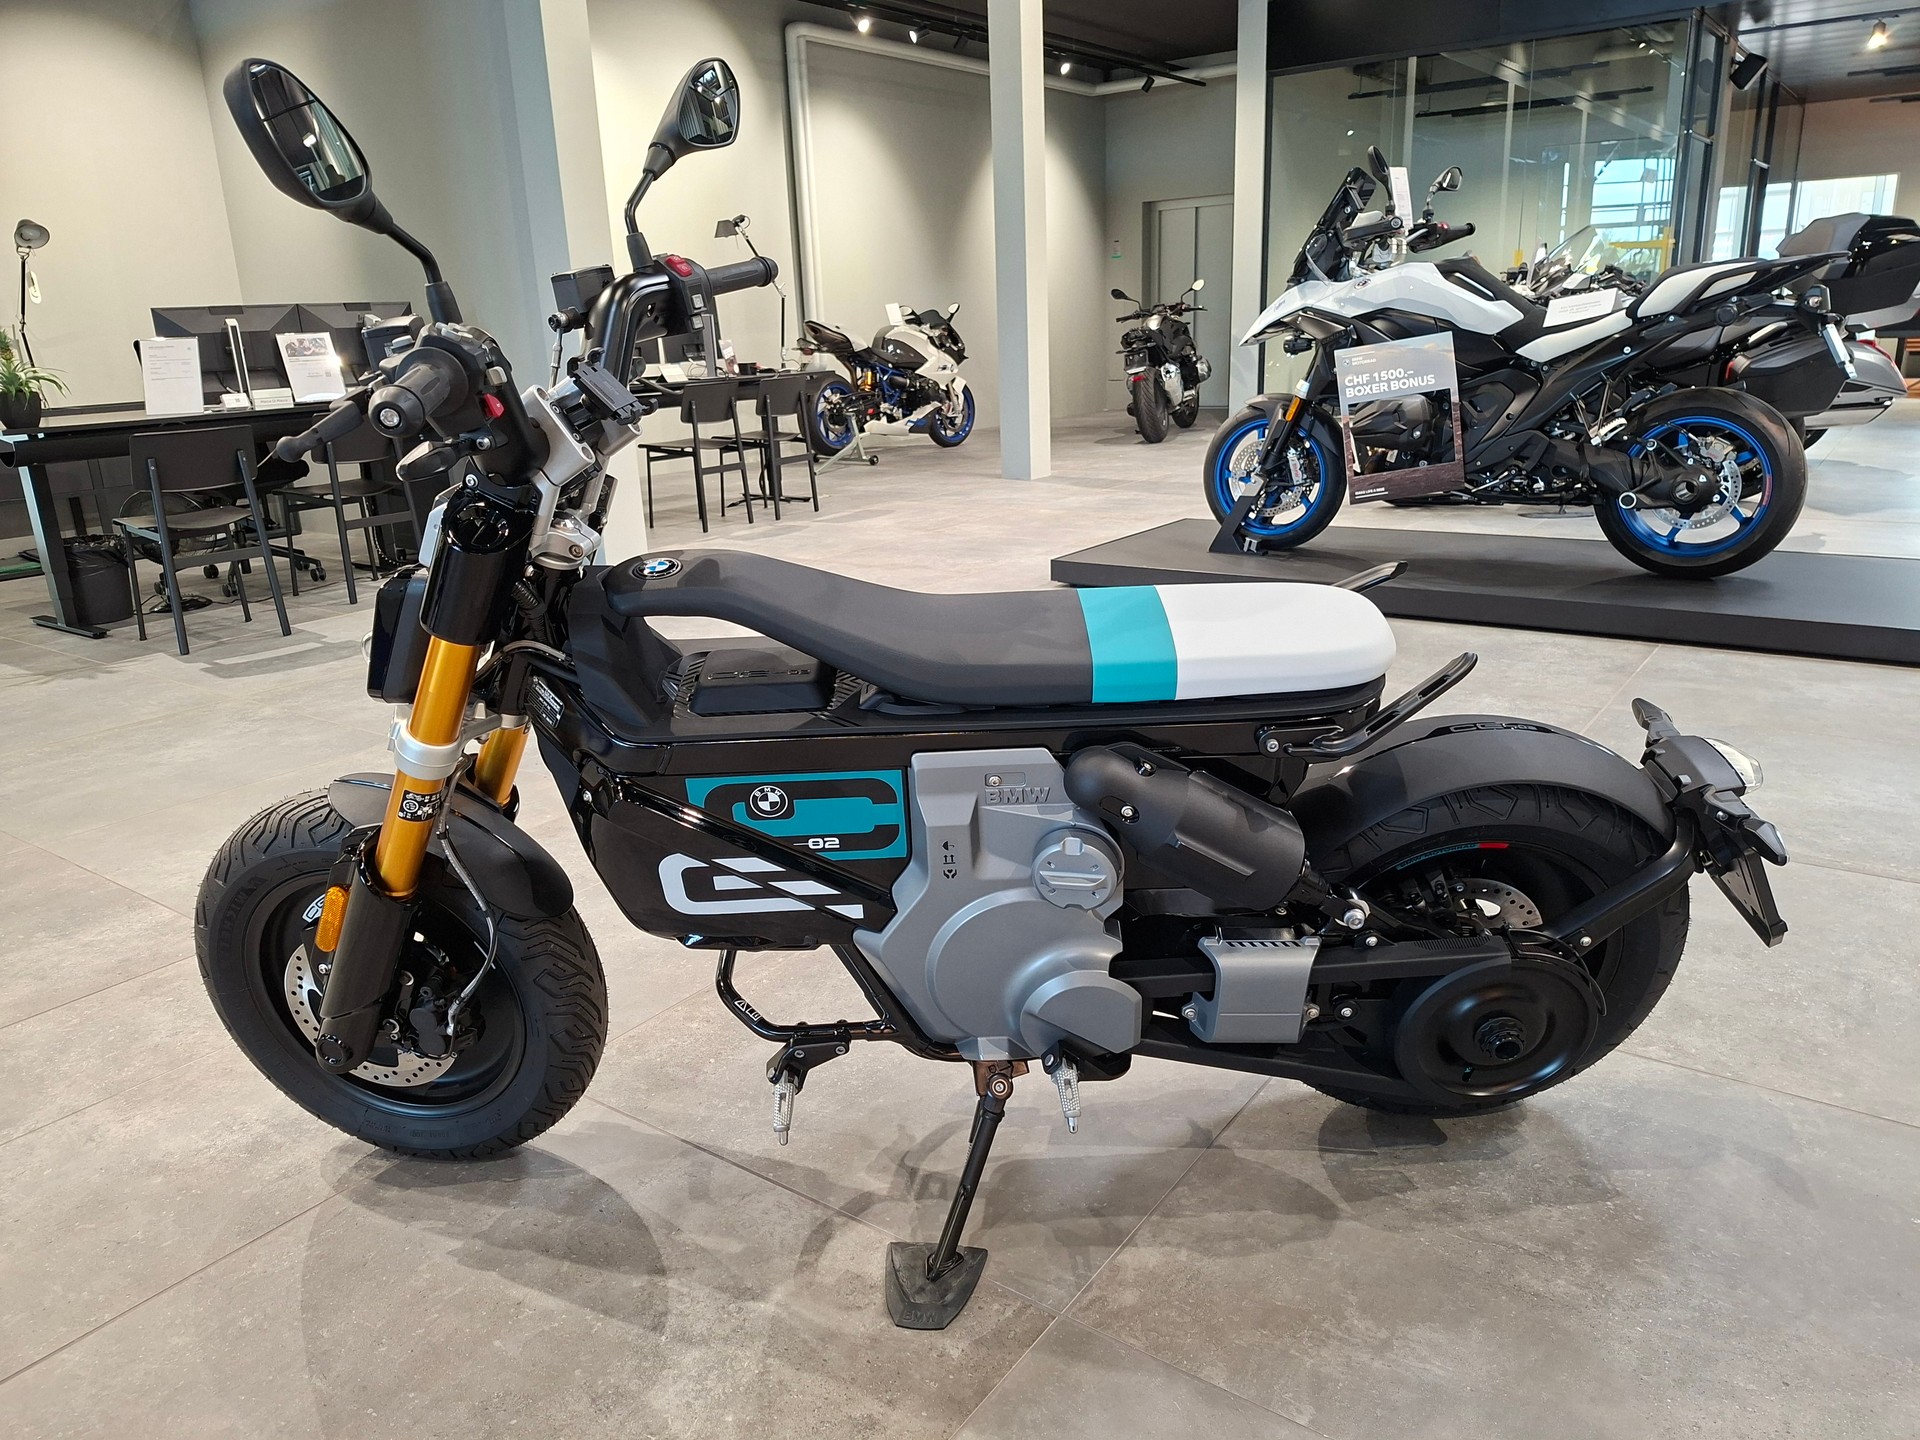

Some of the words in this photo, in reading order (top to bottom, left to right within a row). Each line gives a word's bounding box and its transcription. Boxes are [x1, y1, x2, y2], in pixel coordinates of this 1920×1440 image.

[1344, 373, 1370, 387] CHF
[1345, 381, 1389, 398] BOXER
[1390, 374, 1436, 391] BONUS
[984, 787, 1051, 805] BMW
